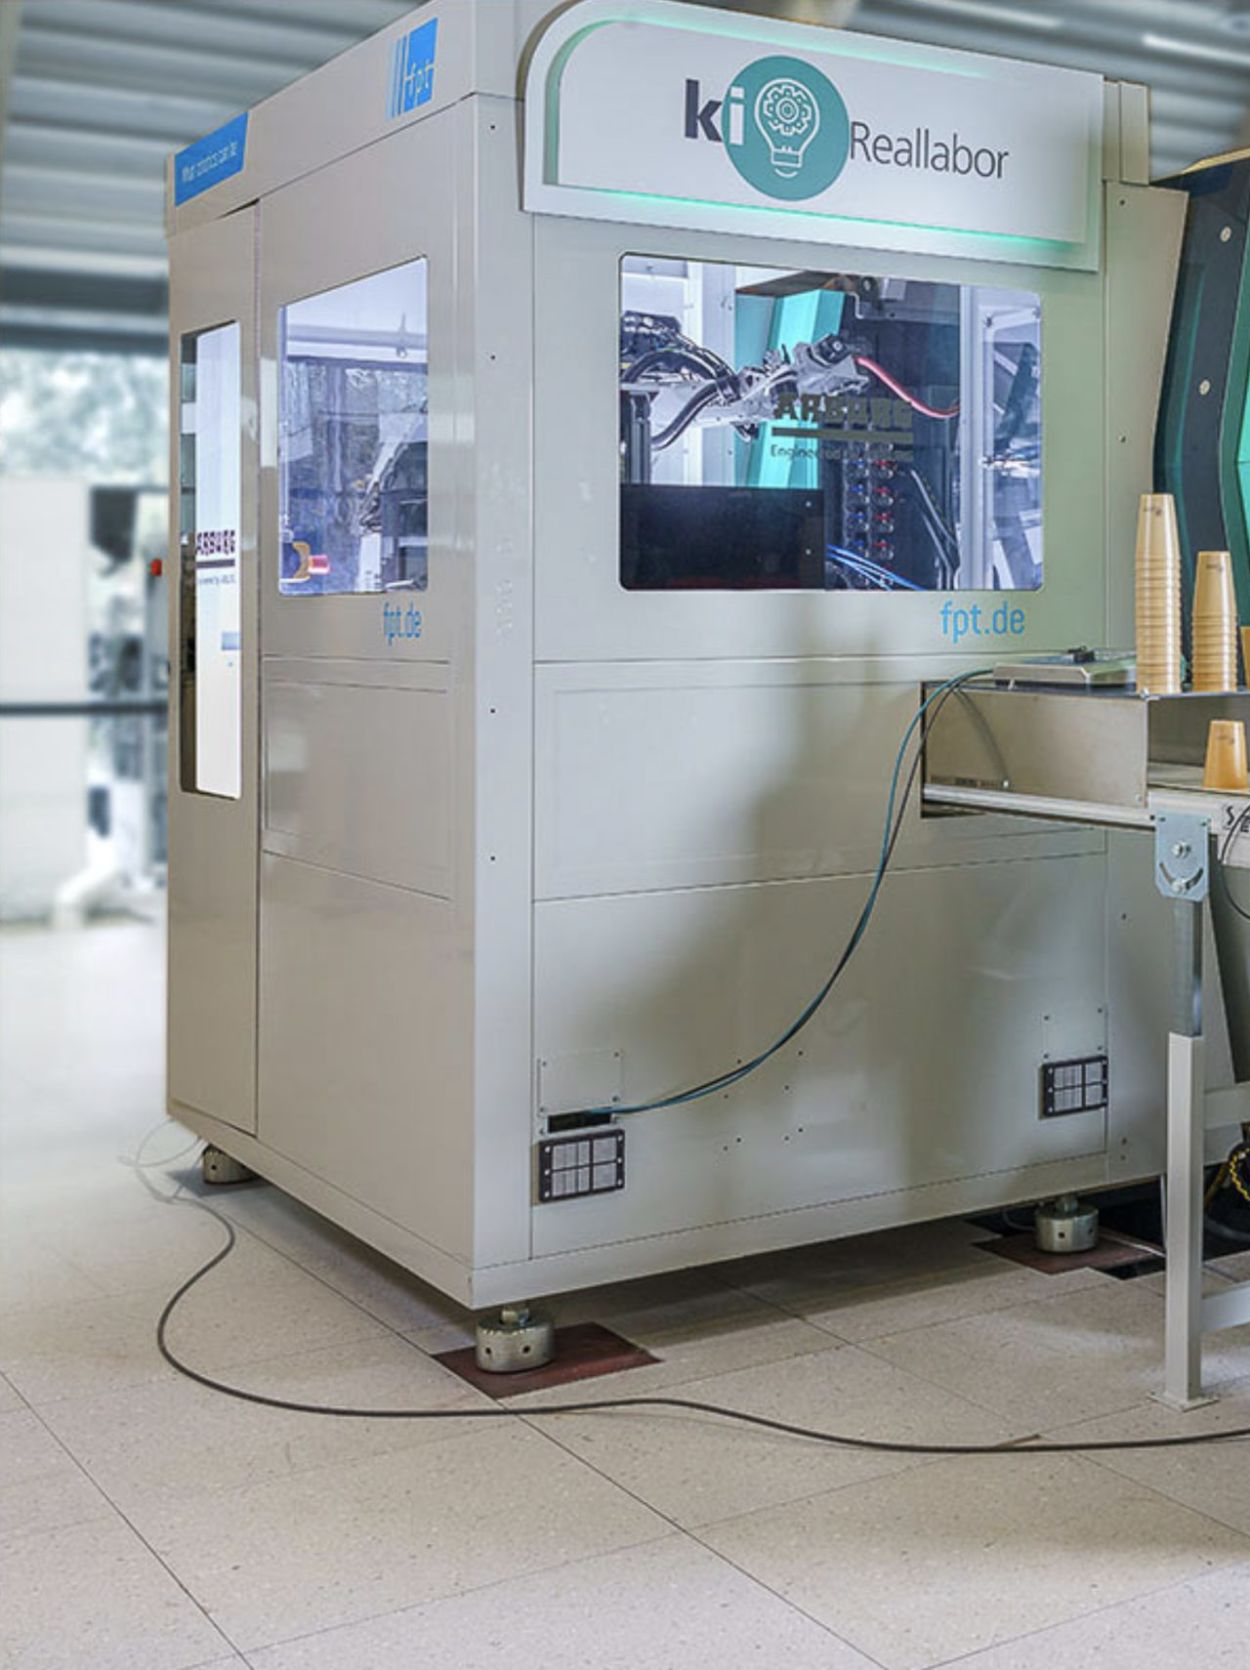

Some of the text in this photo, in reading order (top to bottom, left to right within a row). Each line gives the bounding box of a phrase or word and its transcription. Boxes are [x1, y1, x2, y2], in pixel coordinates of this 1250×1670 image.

[684, 78, 1009, 179] ki Reallabor
[384, 602, 422, 646] fpt.de
[940, 600, 1025, 644] fpt.de
